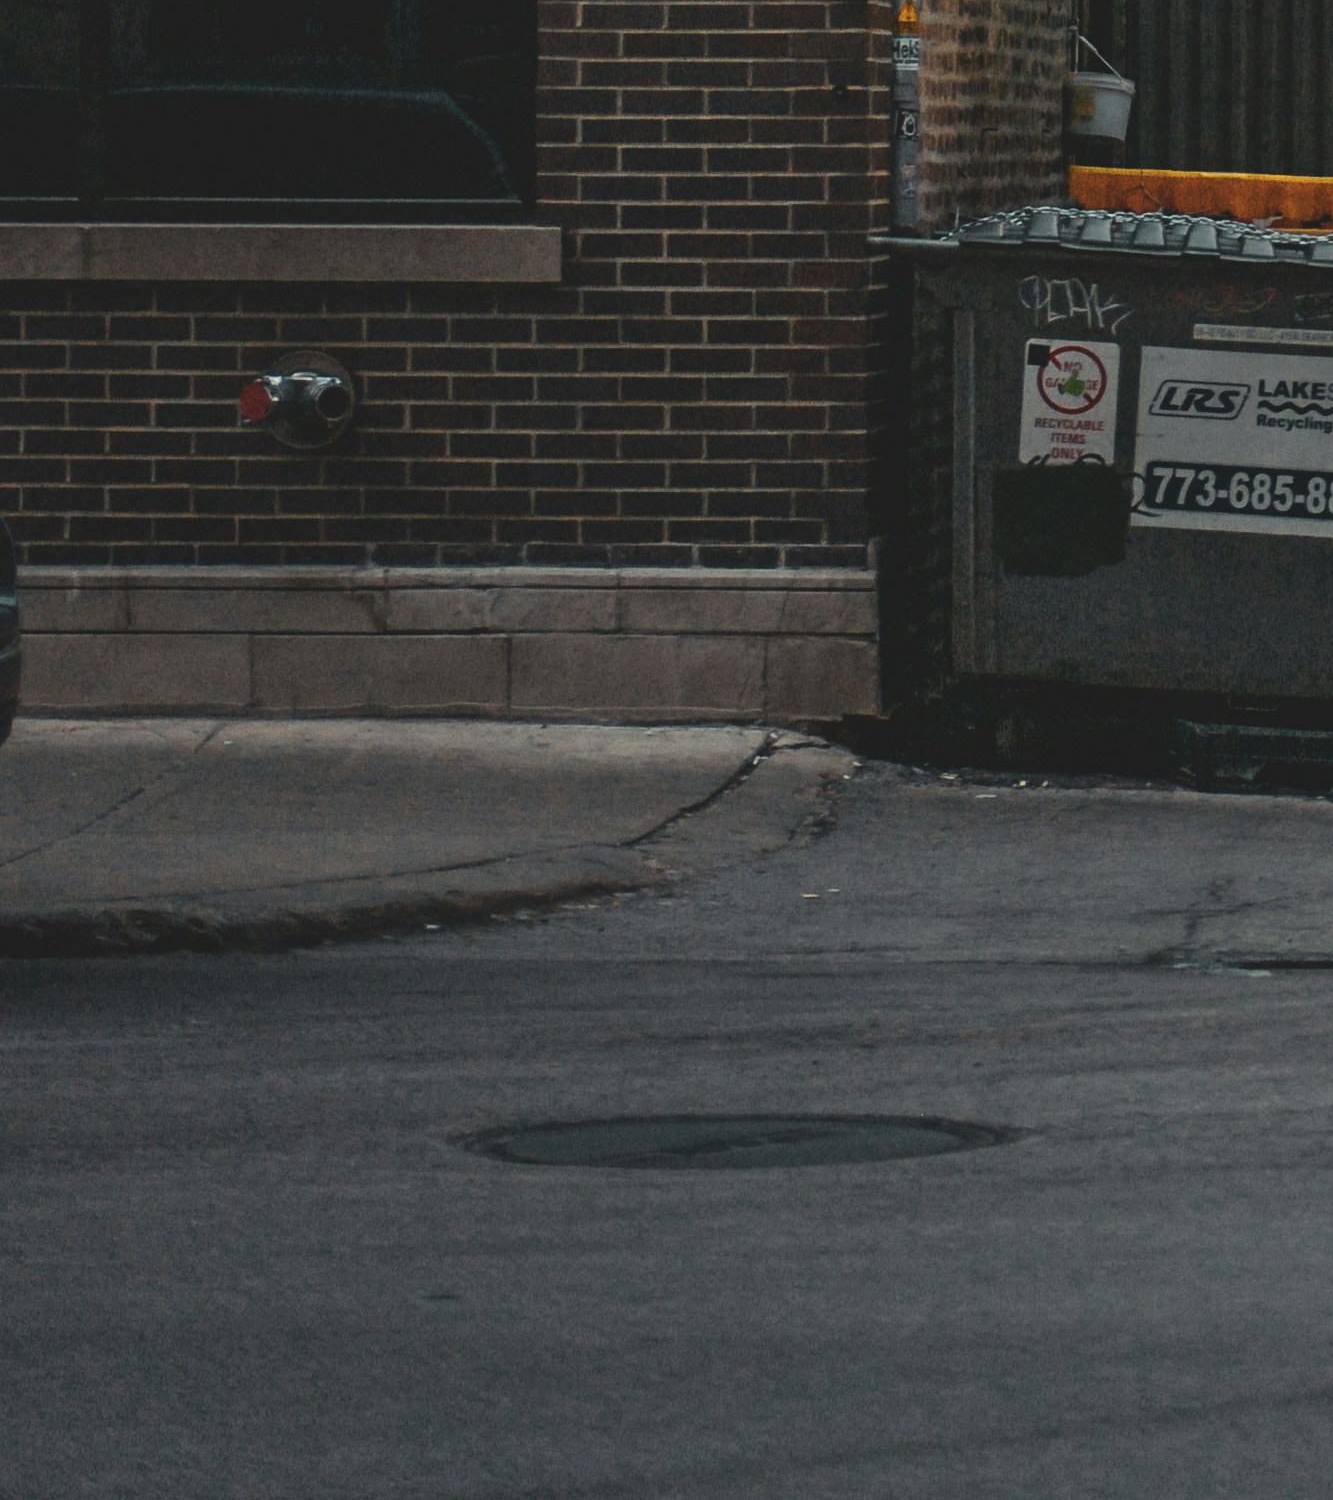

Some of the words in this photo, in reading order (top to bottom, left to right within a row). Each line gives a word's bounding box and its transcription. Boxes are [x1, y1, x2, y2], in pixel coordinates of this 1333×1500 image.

[1159, 386, 1240, 414] LRS
[1034, 418, 1104, 431] RECYCLABLE
[1256, 413, 1333, 434] Recycling
[1050, 433, 1086, 444] ITEMS
[1051, 448, 1085, 459] ONLY
